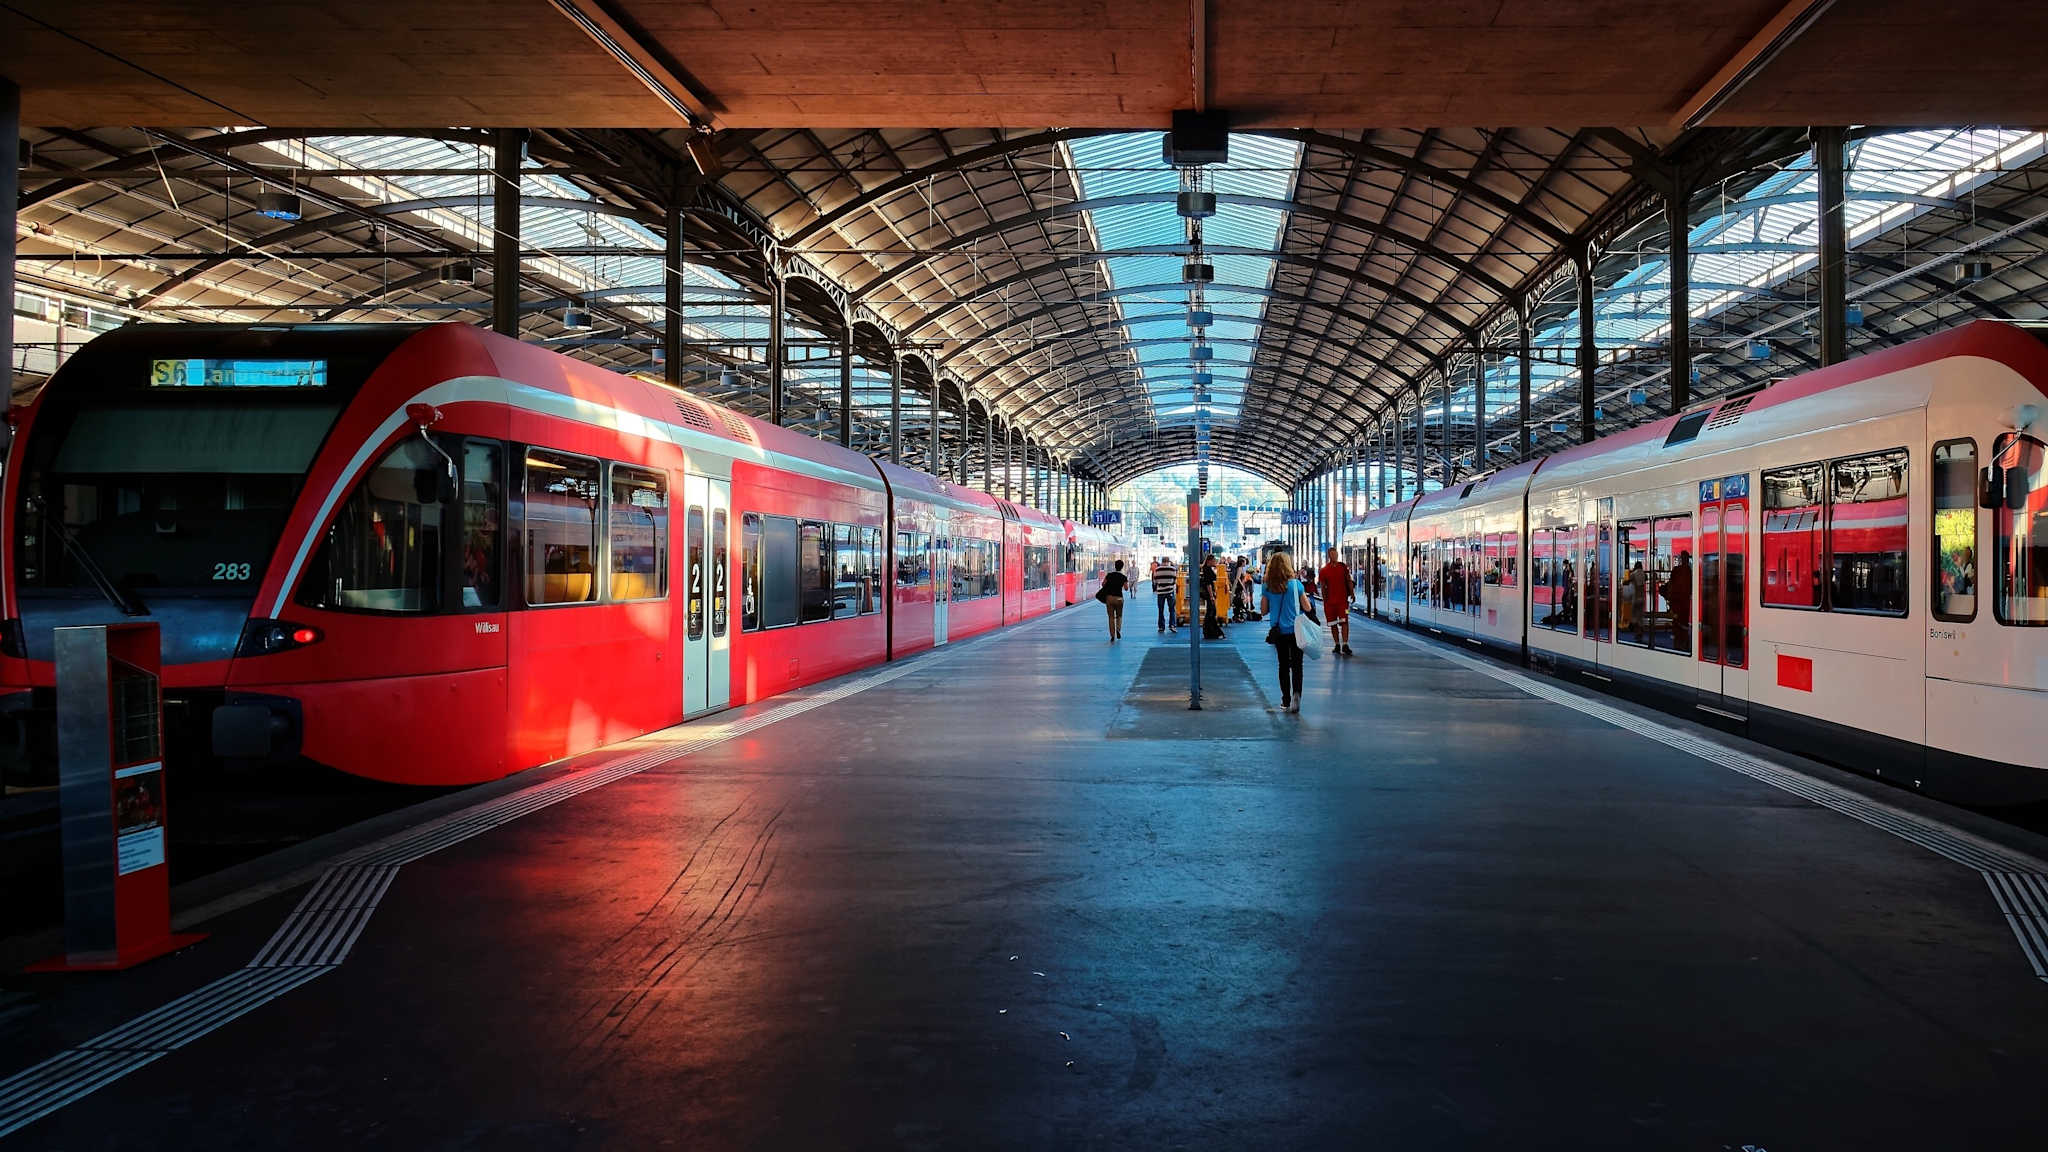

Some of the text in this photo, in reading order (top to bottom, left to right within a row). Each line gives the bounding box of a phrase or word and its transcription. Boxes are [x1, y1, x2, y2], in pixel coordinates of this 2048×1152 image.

[212, 563, 251, 580] 283
[692, 563, 700, 593] 2
[716, 563, 724, 592] 2
